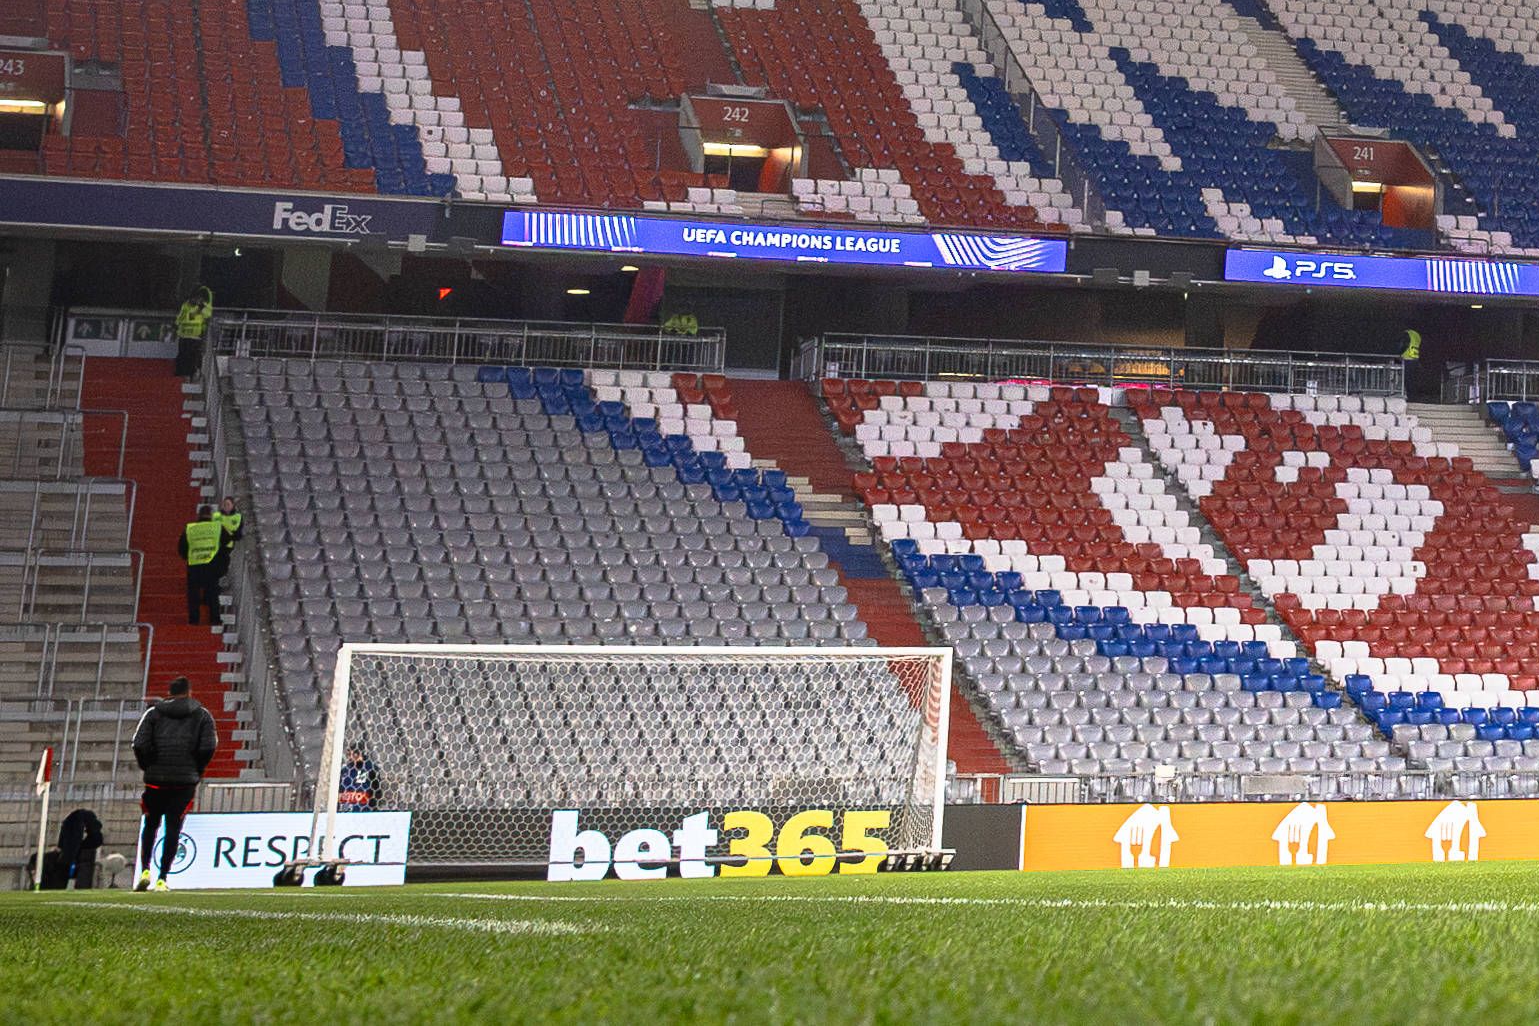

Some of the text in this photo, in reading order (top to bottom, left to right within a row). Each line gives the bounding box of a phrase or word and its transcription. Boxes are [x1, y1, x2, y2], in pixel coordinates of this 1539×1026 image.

[723, 106, 749, 123] 242
[1353, 147, 1374, 161] 241
[273, 201, 372, 234] FedEx
[682, 227, 901, 253] UEFA CHAMPIONS LEAGUE
[1295, 260, 1355, 280] PS5
[548, 810, 890, 882] bet365
